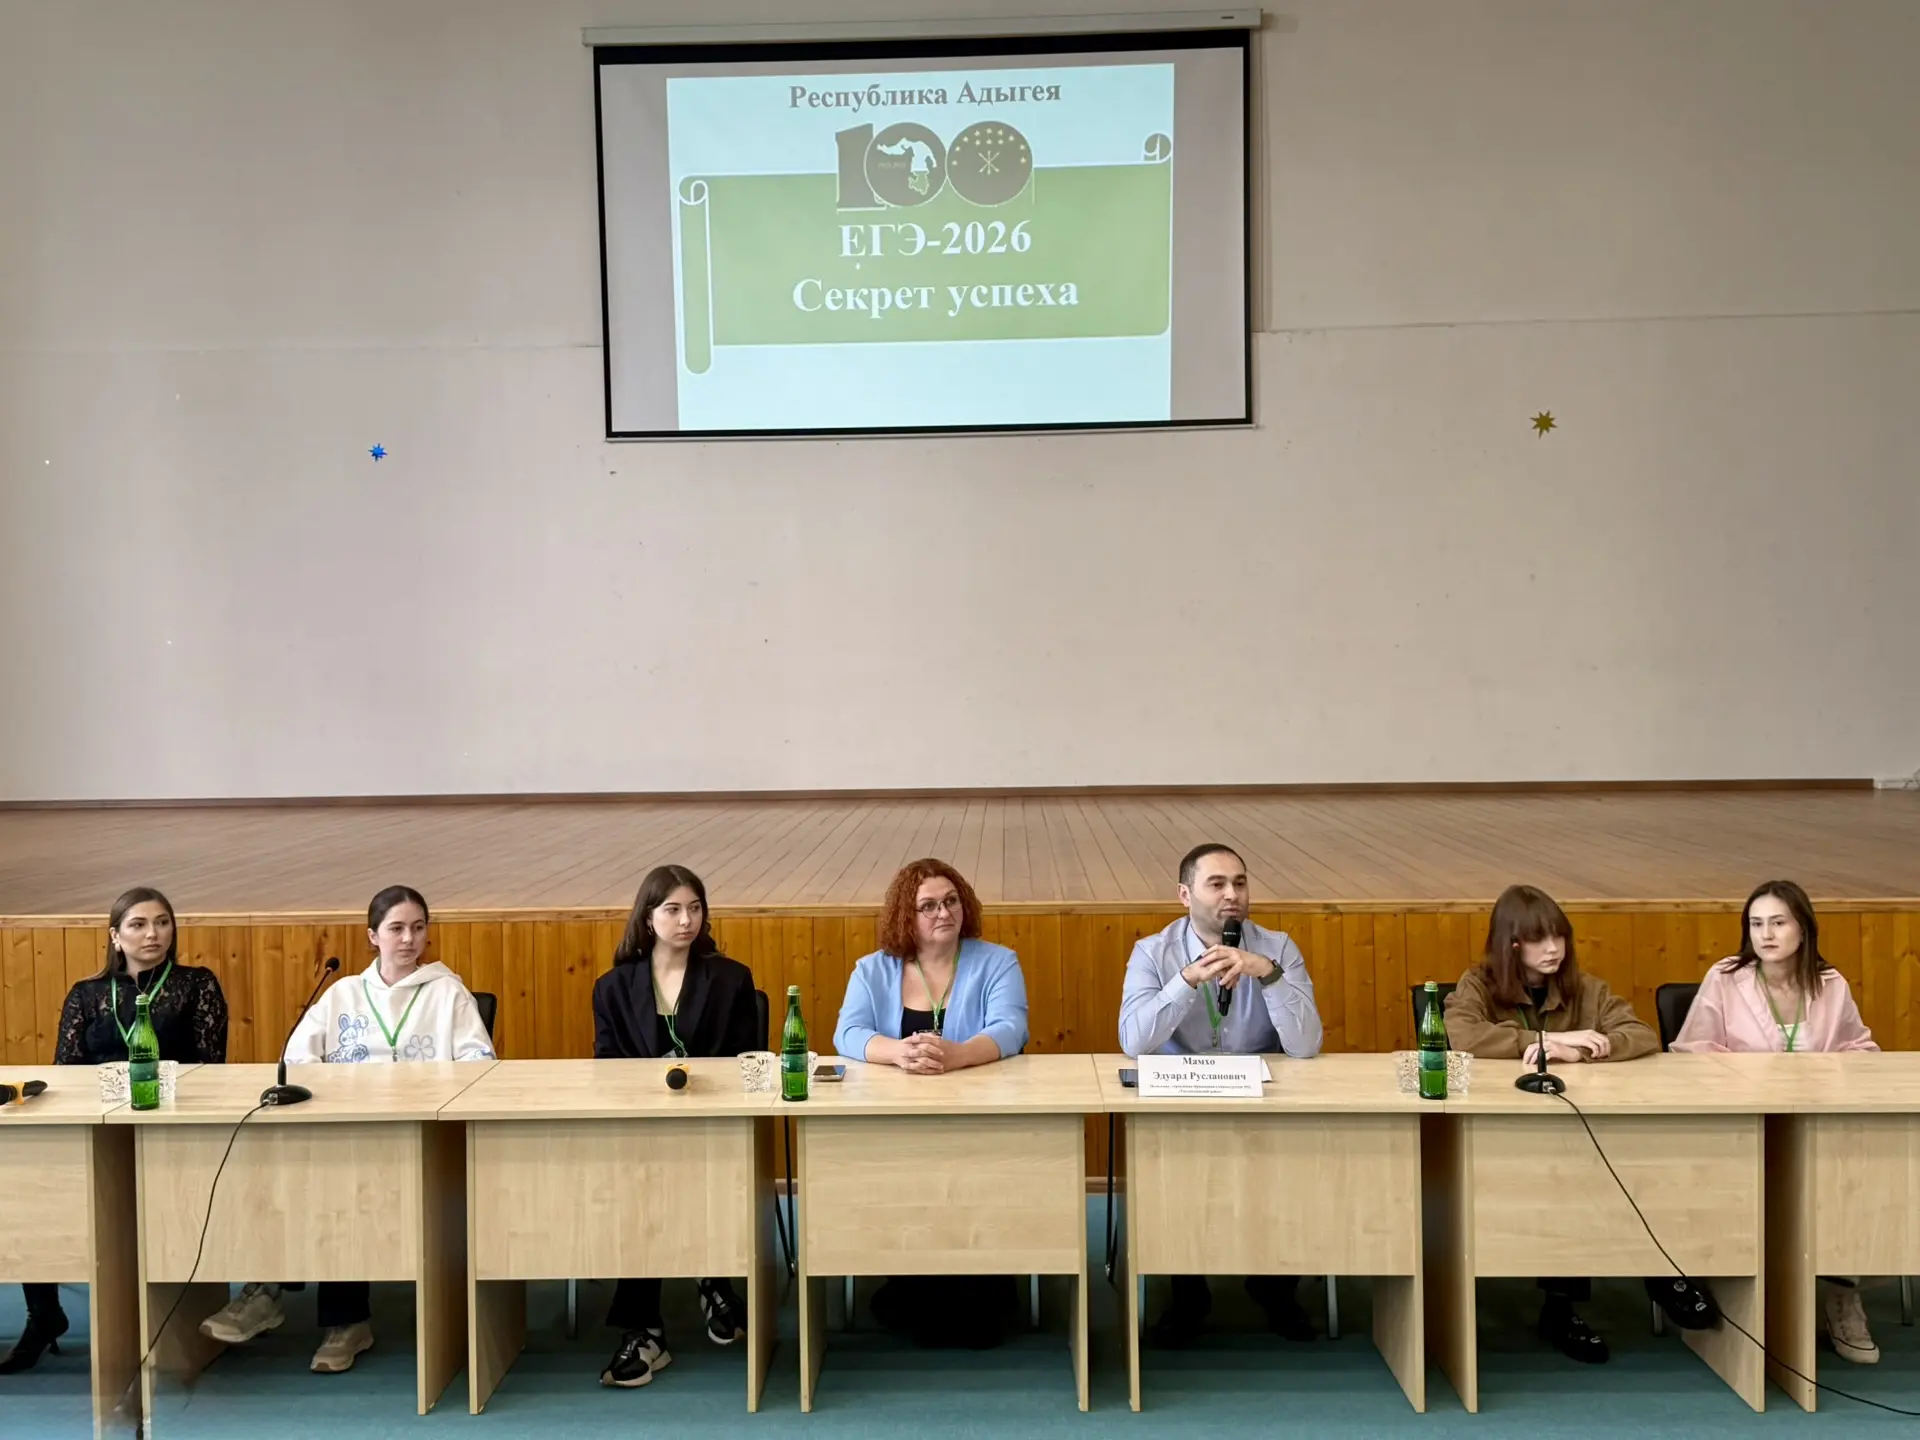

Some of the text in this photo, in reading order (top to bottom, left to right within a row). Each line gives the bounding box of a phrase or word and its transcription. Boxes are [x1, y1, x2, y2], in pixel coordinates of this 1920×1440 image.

[789, 80, 1061, 113] Республика Адыгея
[838, 220, 1032, 257] ЕГЭ-2026
[792, 278, 1079, 319] Секрет успеха
[1153, 1071, 1247, 1082] Эдуард Русланович
[1182, 1057, 1216, 1066] Мамхо
